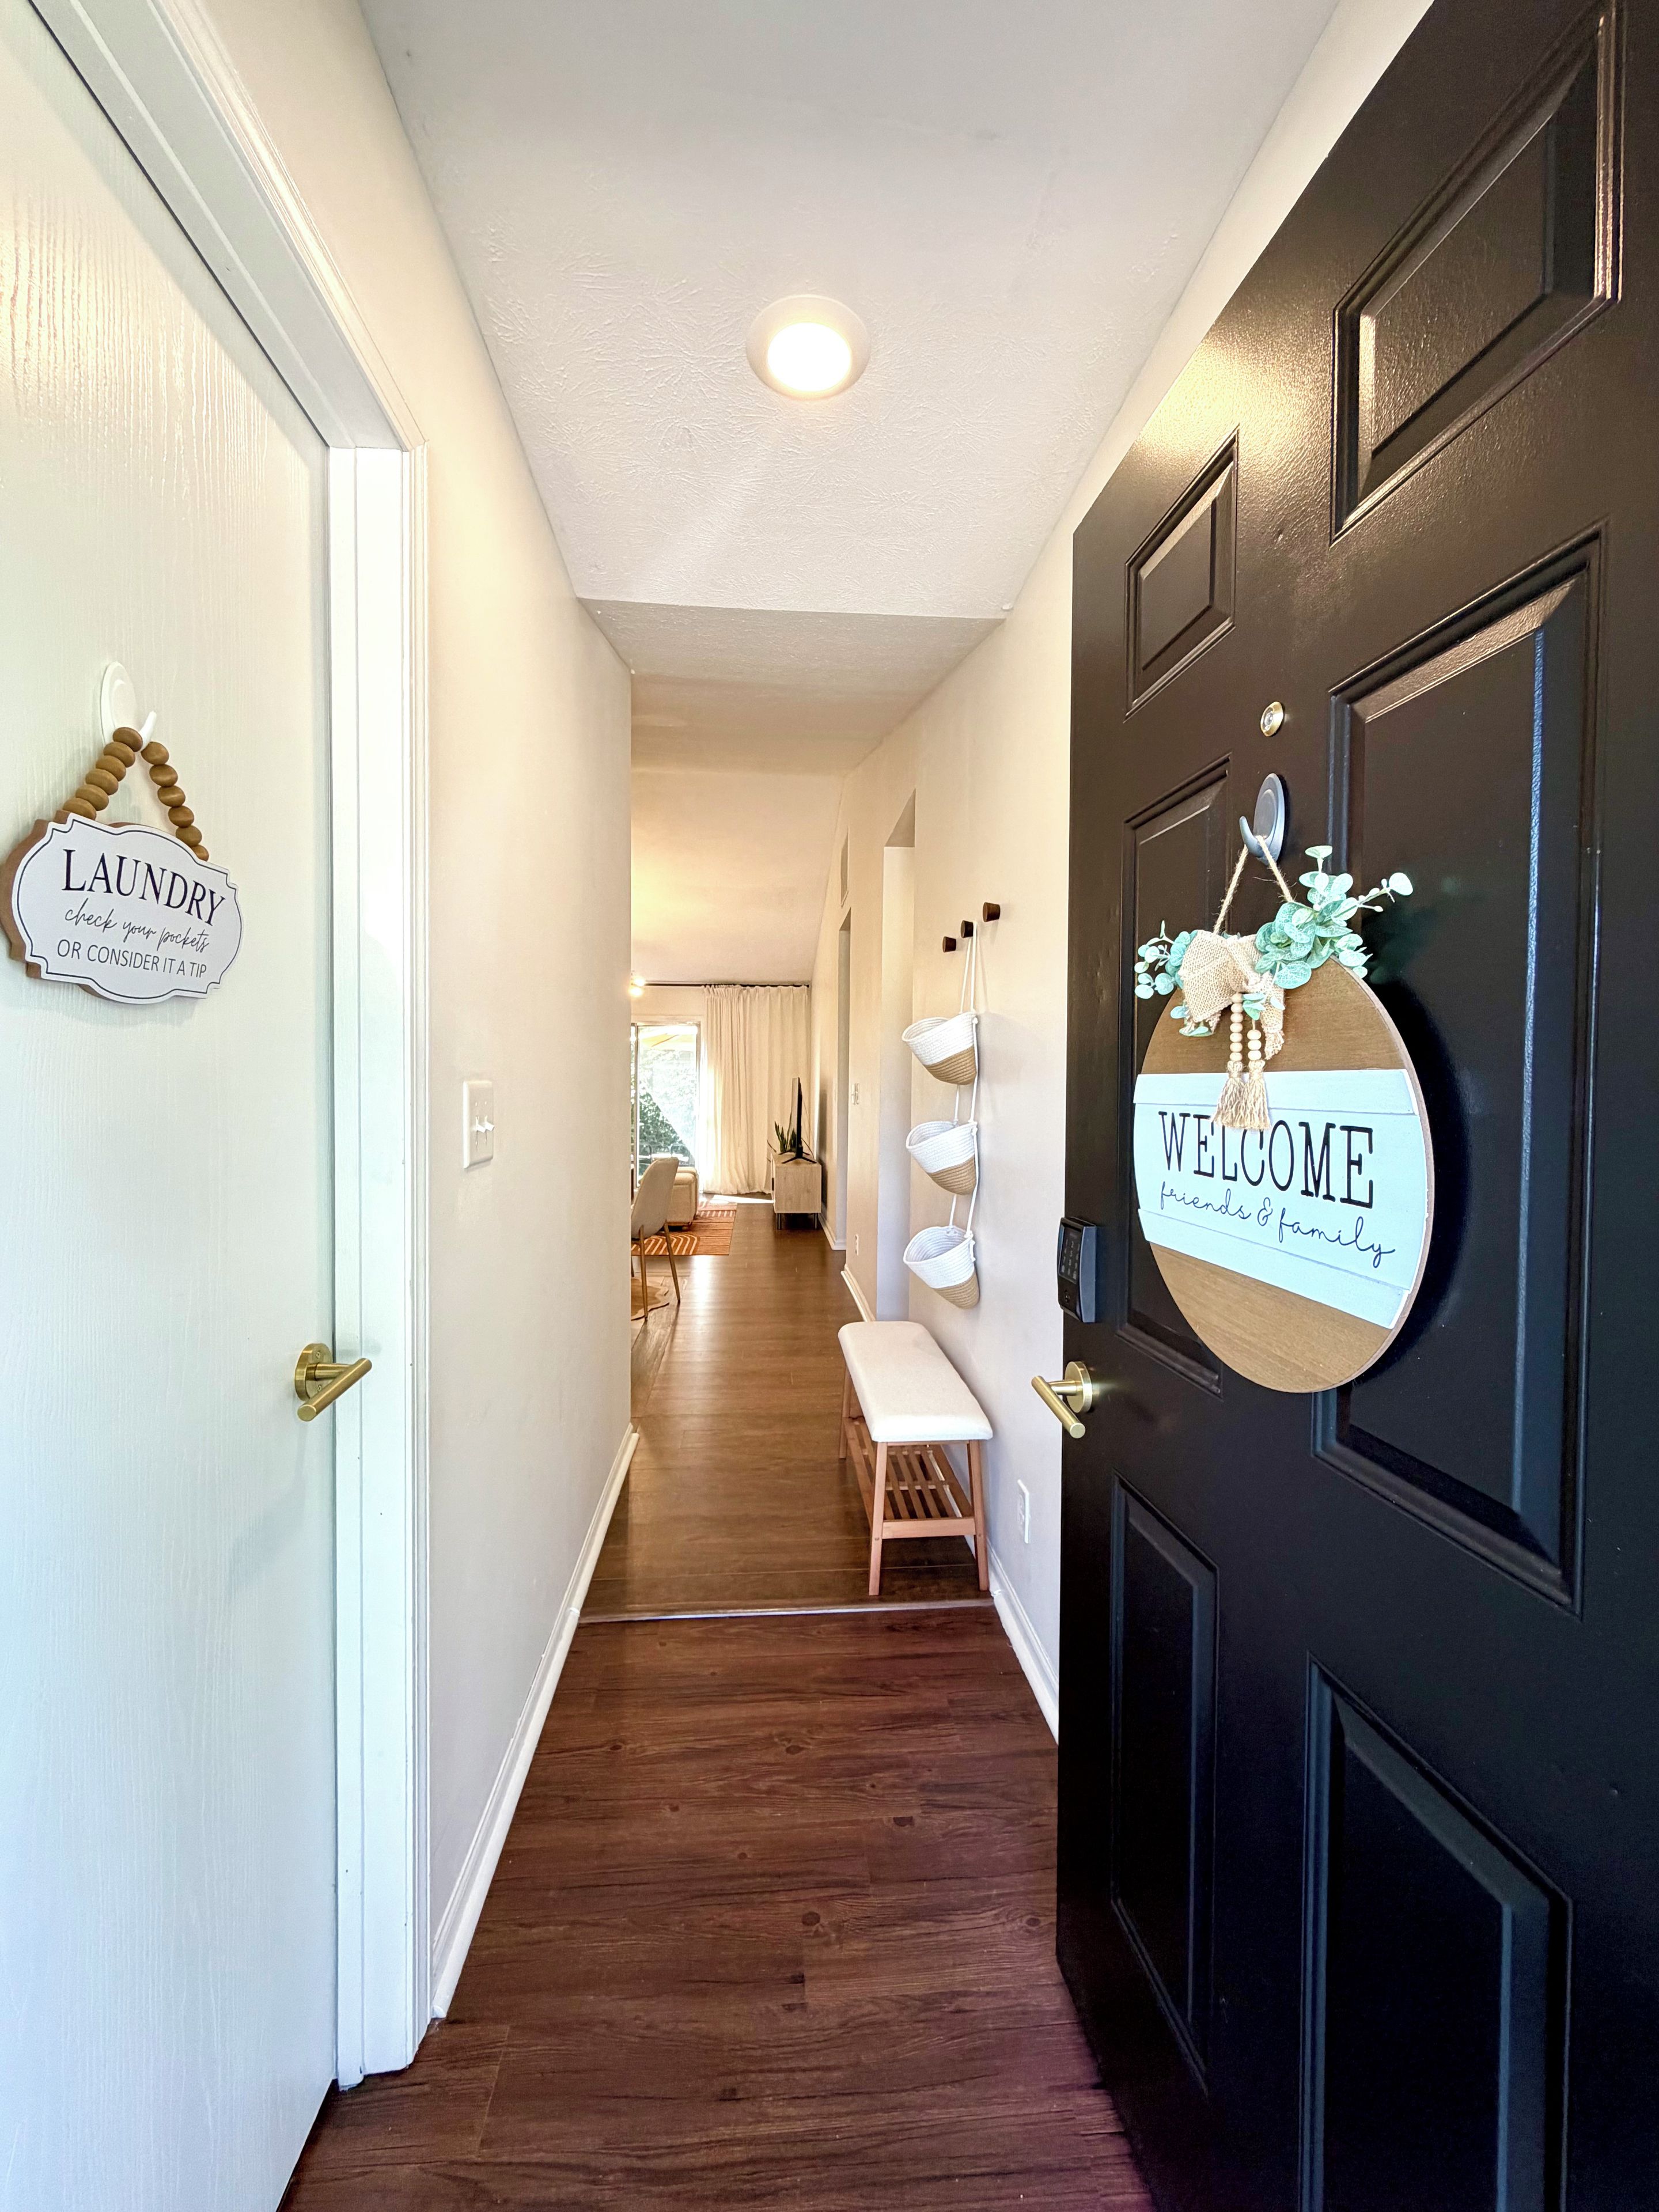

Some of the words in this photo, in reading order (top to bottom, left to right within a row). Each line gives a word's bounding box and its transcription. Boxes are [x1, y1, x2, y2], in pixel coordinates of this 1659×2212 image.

[61, 849, 226, 926] LAUNDRY
[65, 897, 118, 933] check
[122, 921, 157, 943] your
[156, 927, 210, 953] pockets
[57, 938, 82, 960] OR
[87, 944, 160, 972] CONSIDER
[162, 957, 176, 974] IT
[176, 960, 185, 976] A
[189, 961, 207, 978] TIP
[1158, 1111, 1374, 1209] WELCOME
[1160, 1181, 1252, 1220] friends
[1257, 1196, 1272, 1226] &
[1278, 1207, 1396, 1269] family
